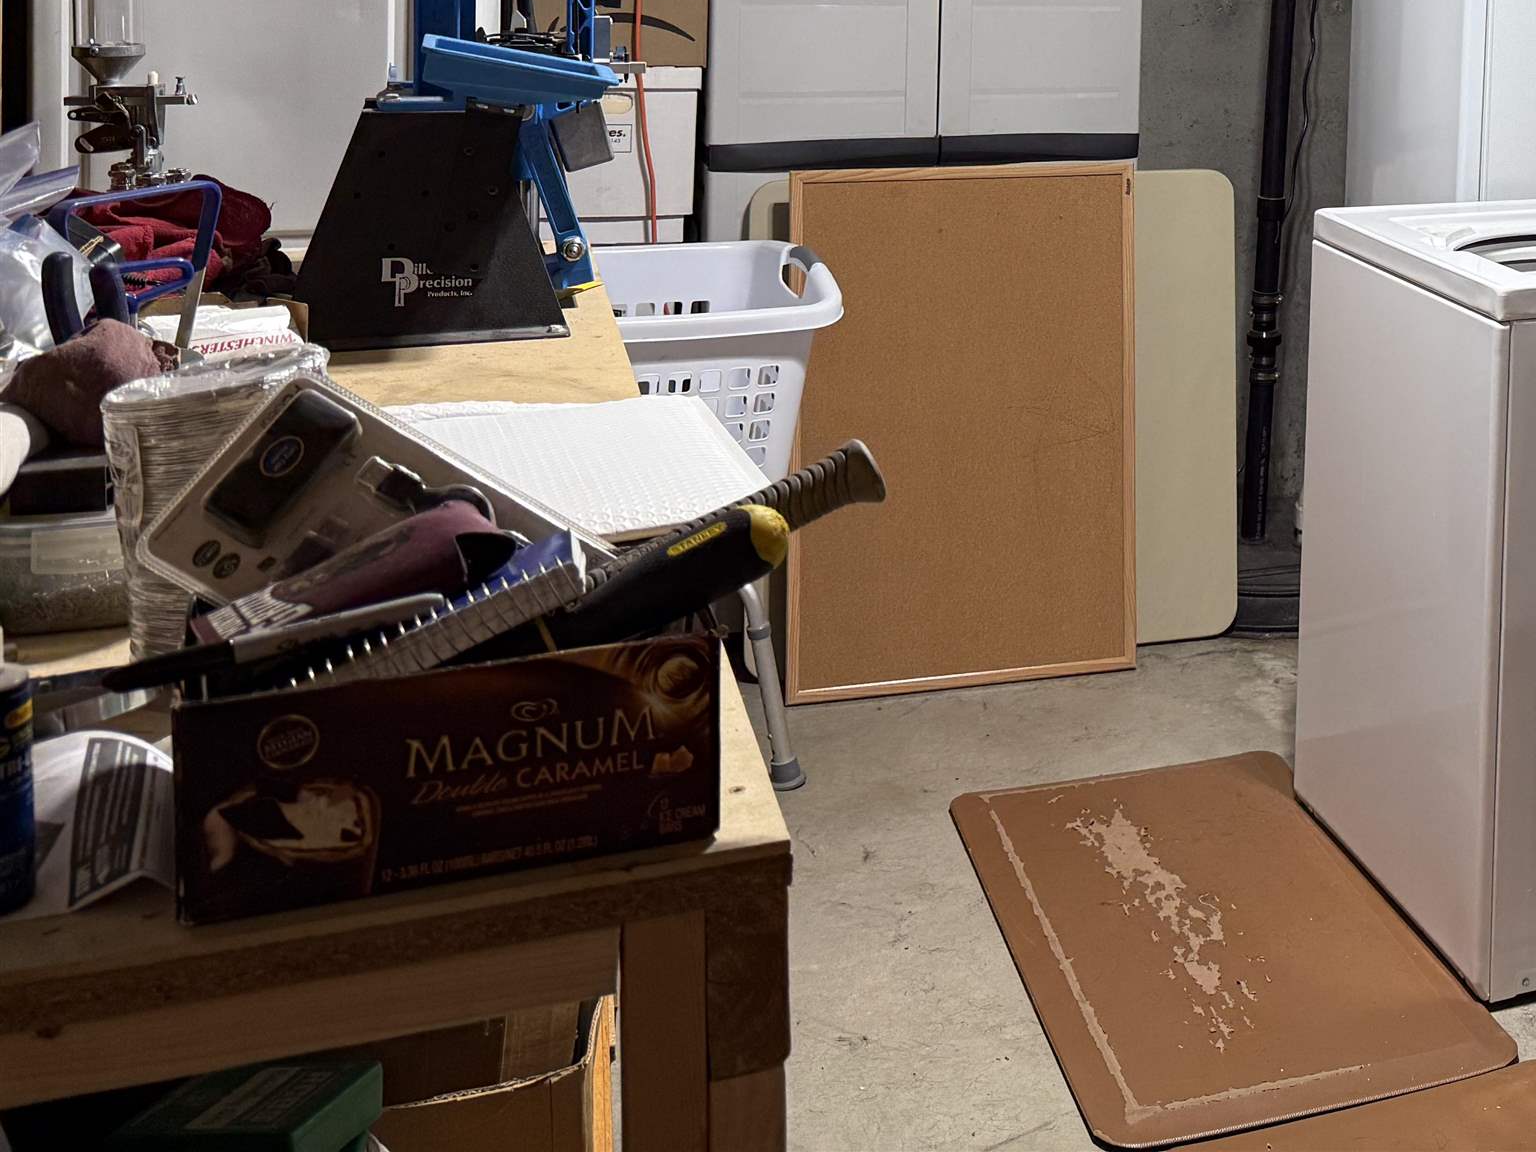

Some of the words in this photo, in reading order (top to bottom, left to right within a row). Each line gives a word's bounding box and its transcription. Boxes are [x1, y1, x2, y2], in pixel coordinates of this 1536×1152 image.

[460, 289, 473, 297] Inc.
[405, 708, 656, 779] MAGNUM
[410, 773, 508, 805] Double
[516, 751, 645, 789] CARAMEL
